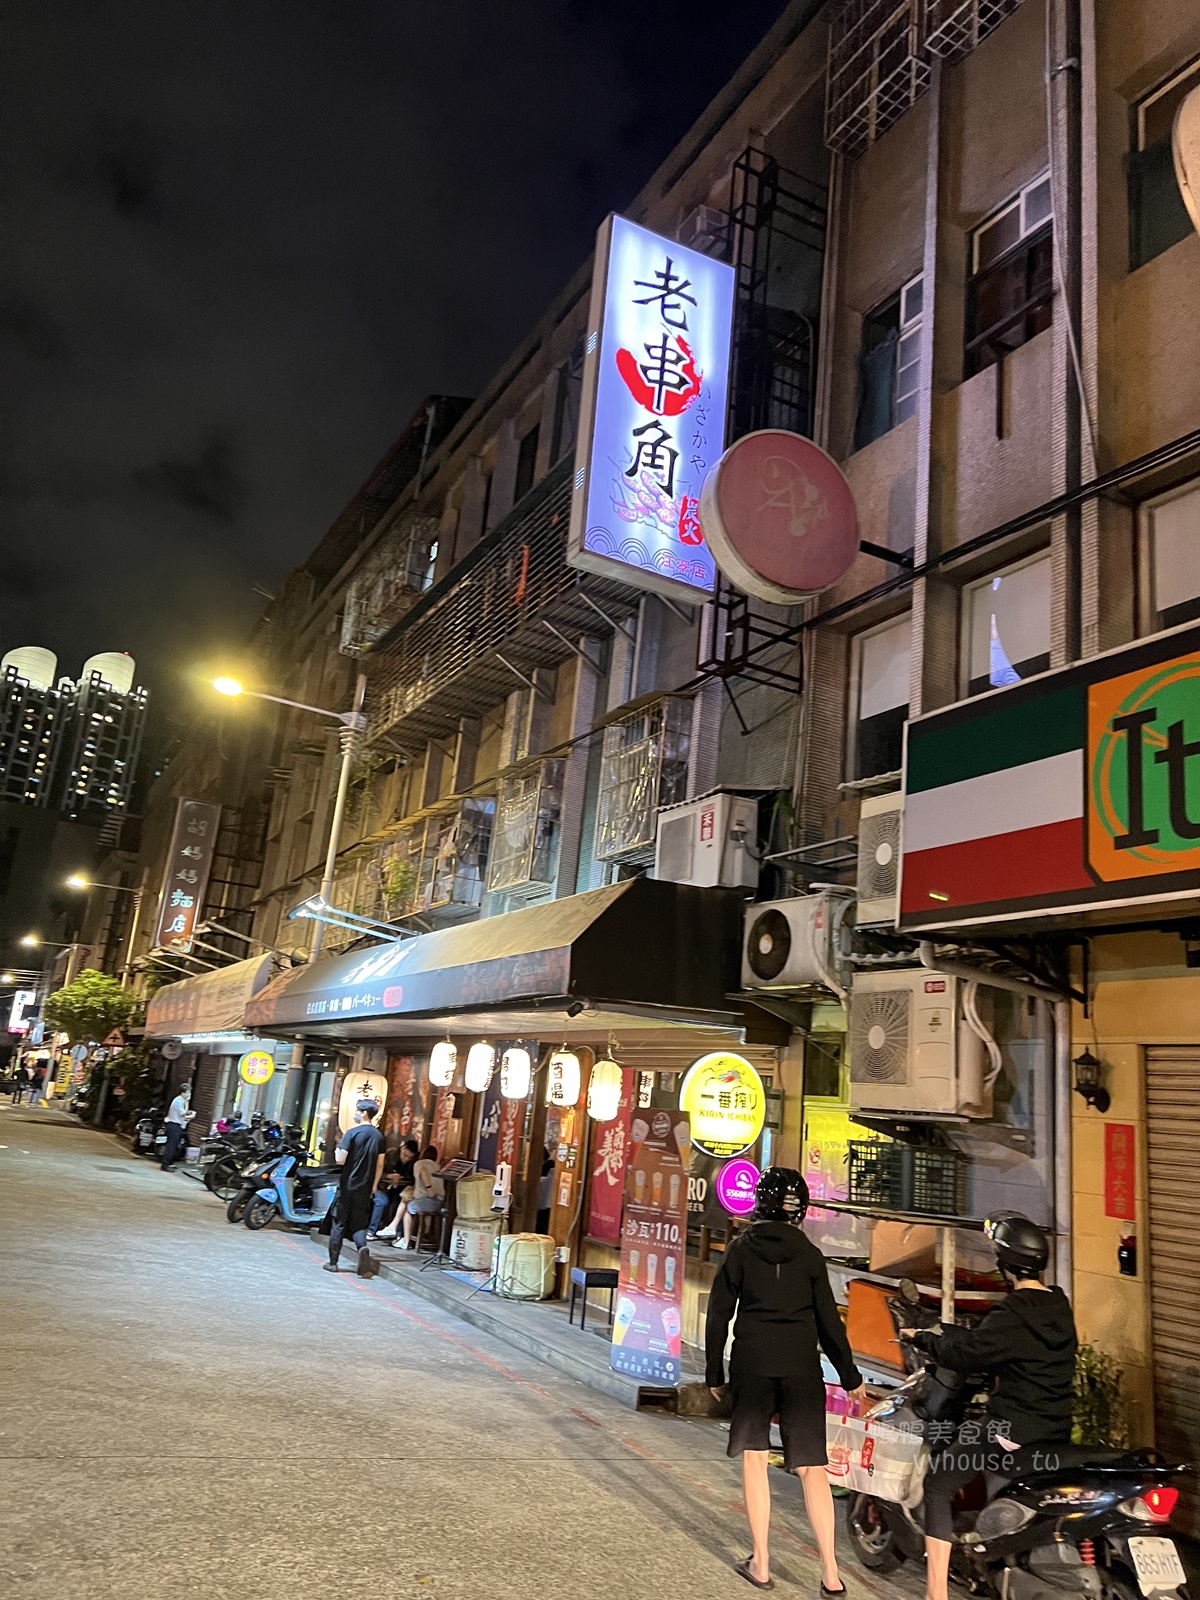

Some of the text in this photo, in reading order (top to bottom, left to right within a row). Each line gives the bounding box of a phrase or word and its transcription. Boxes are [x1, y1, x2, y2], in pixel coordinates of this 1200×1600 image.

[624, 256, 697, 498] 老串角
[690, 387, 711, 474] いざかや
[661, 553, 706, 579] 江翠店
[701, 1091, 758, 1110] 一番搾り
[699, 1109, 756, 1122] KIRIN ICHIBAN
[687, 1202, 705, 1213] EER
[626, 1219, 650, 1238] 沙瓦
[655, 1222, 679, 1243] 110
